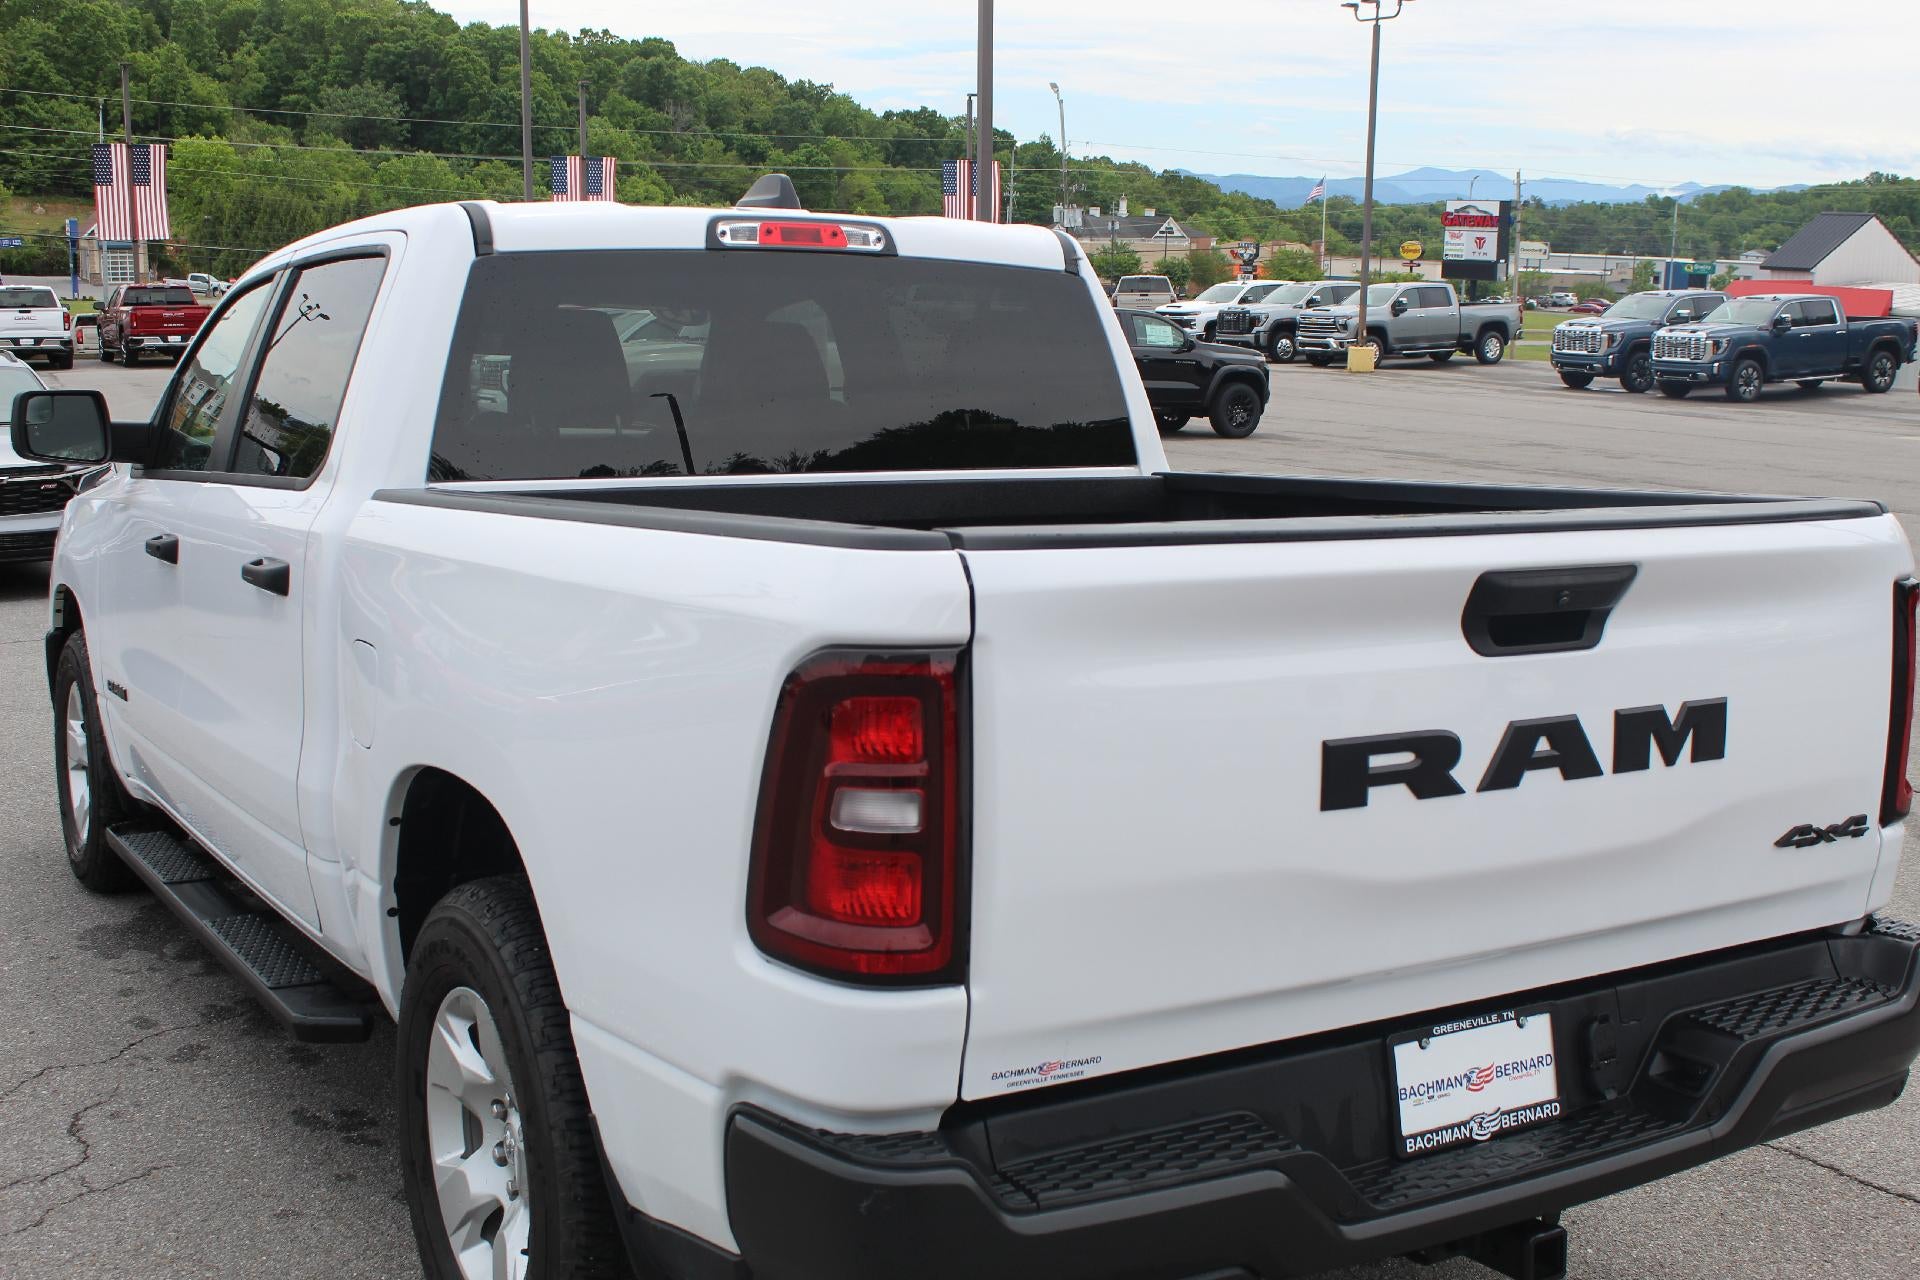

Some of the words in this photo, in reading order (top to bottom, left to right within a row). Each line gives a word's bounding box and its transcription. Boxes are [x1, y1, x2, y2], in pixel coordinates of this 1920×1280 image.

[1441, 211, 1499, 227] GATEWAY
[1320, 696, 1728, 812] RAM
[1433, 1014, 1501, 1035] GREENEVILLE,
[1502, 1010, 1515, 1021] TN
[991, 1067, 1037, 1082] BACHMAN
[1059, 1055, 1102, 1070] BERNARD
[1006, 1076, 1048, 1088] GREENEVILLE
[1049, 1070, 1085, 1081] TENNESSEE
[1399, 1073, 1463, 1101] BACHMAN
[1495, 1053, 1553, 1078] BERNARD
[1406, 1124, 1470, 1153] BACHMAN
[1501, 1102, 1561, 1129] BERNARD
